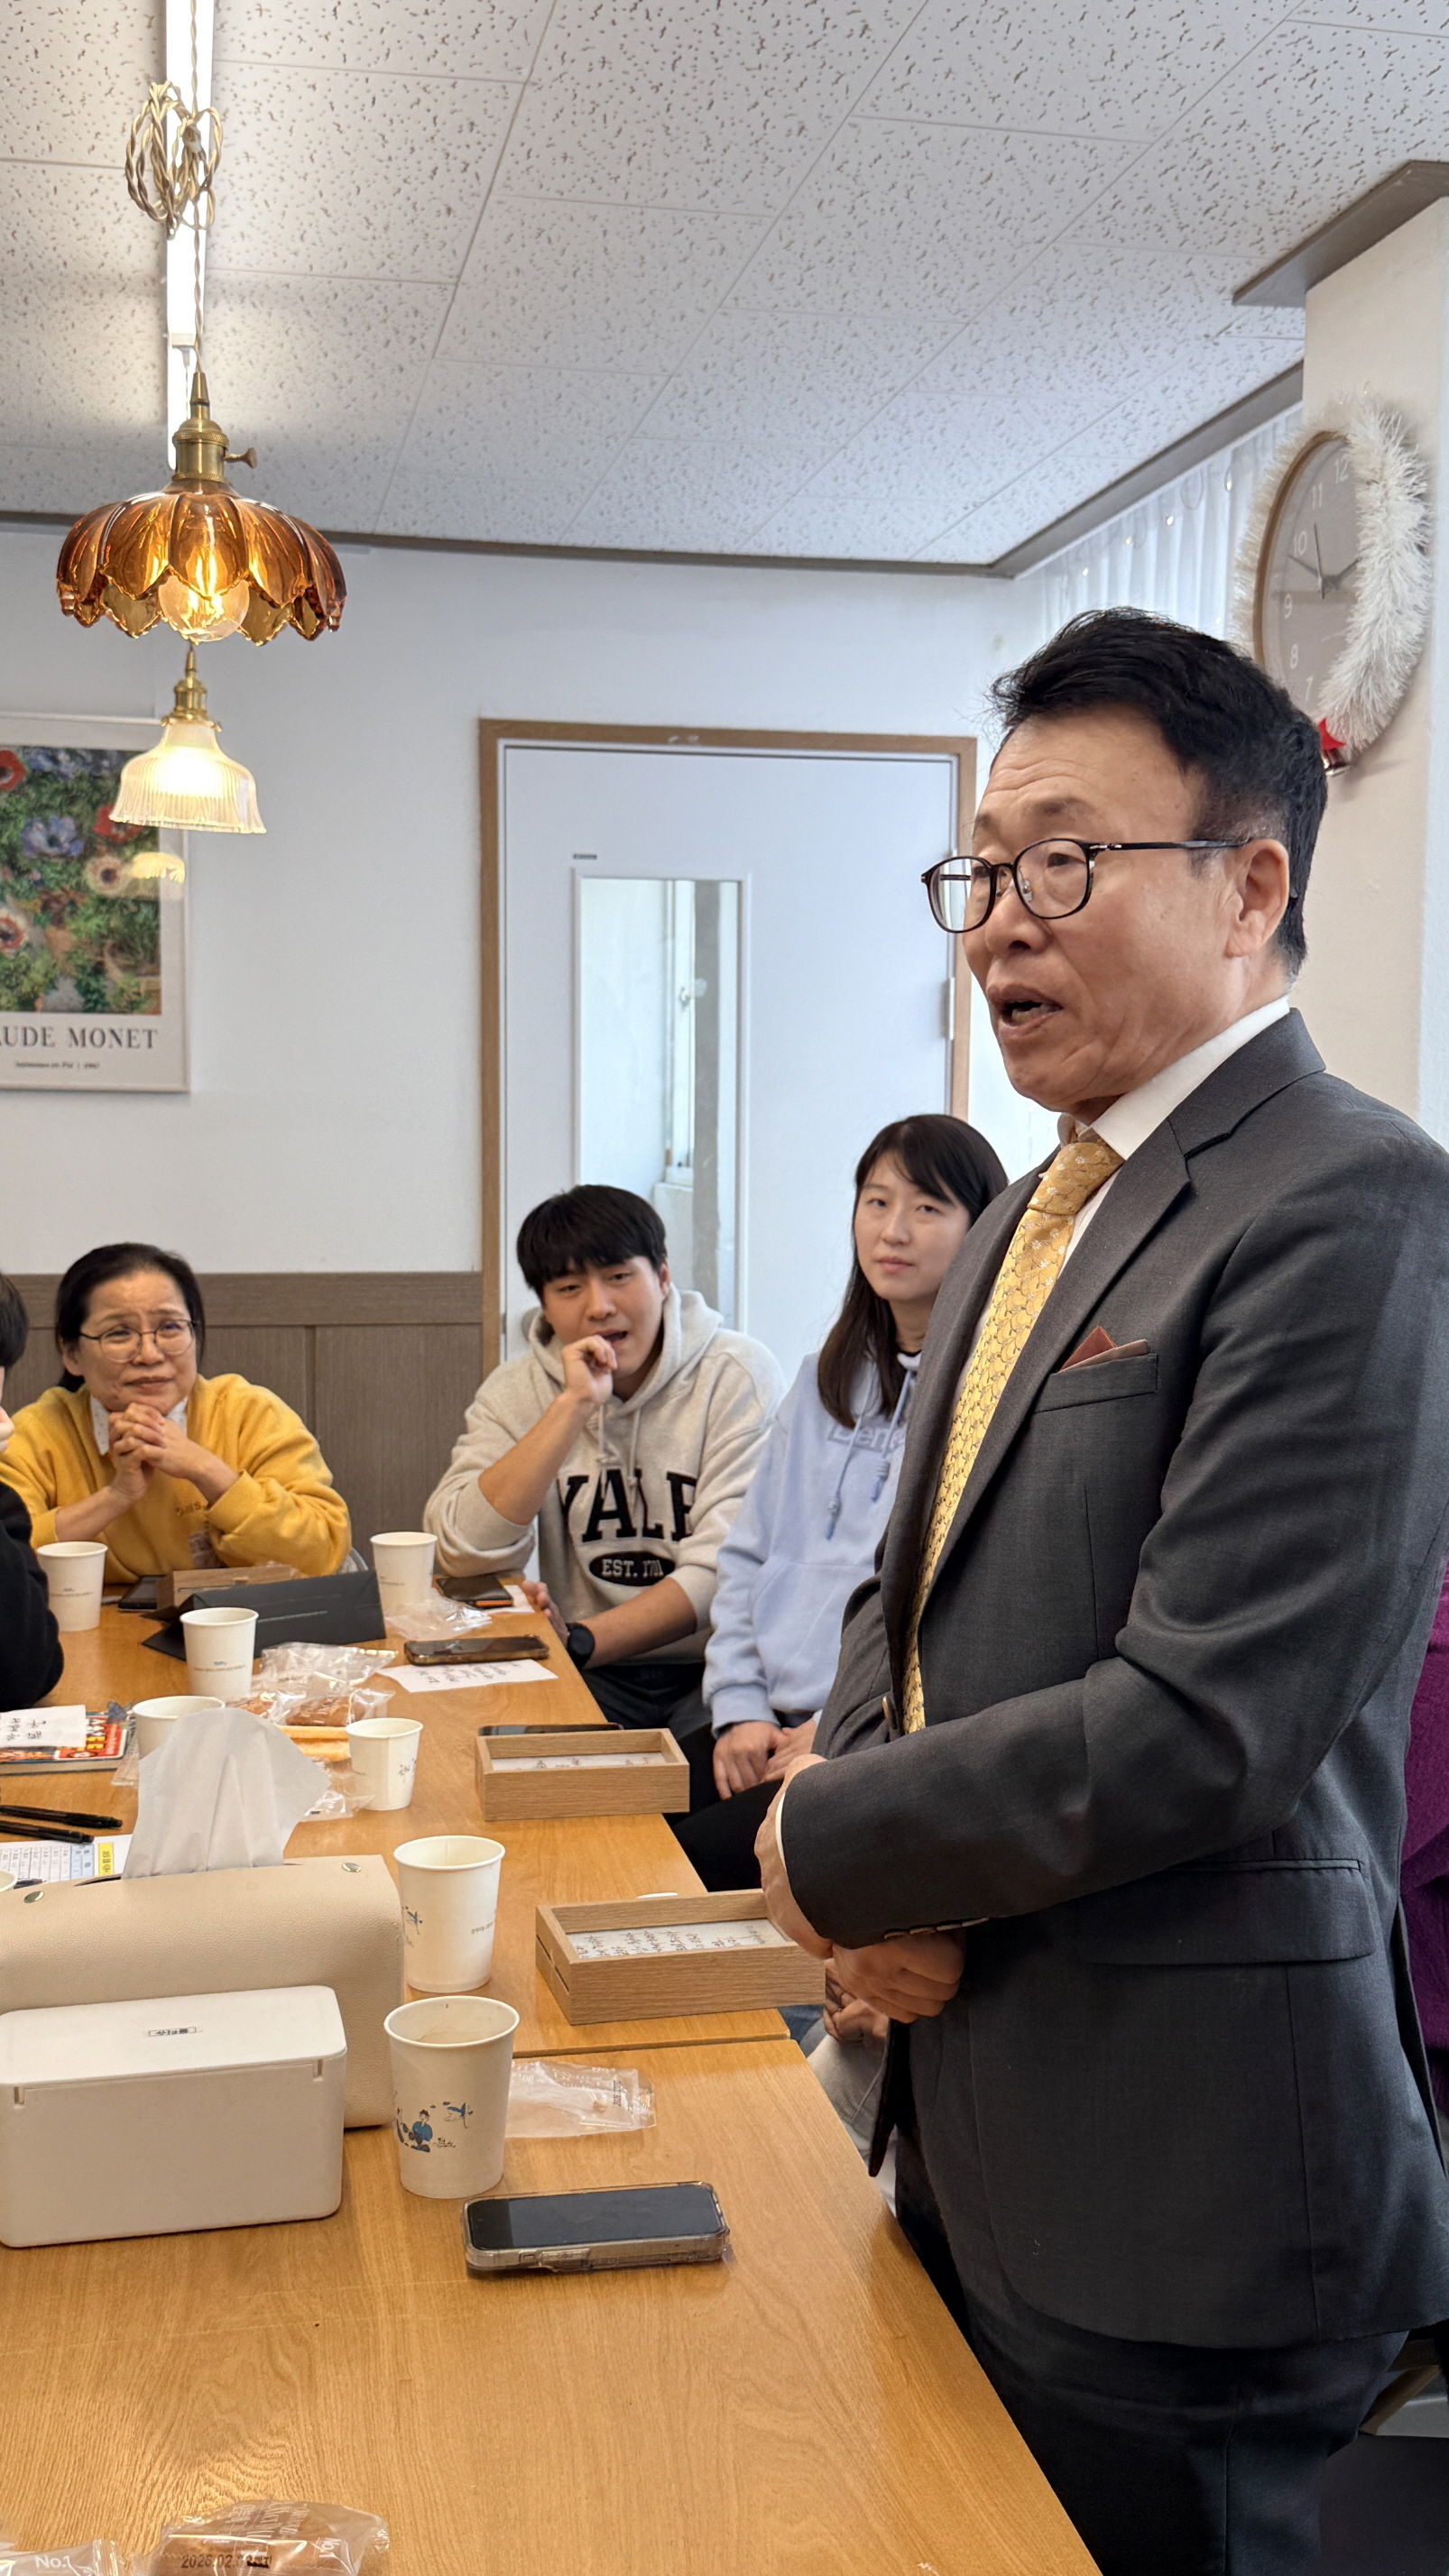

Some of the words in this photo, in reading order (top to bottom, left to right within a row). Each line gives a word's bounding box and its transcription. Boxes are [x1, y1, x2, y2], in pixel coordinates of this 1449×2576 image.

[1334, 457, 1349, 483] 12
[1311, 482, 1323, 510] 11
[1293, 530, 1307, 556] 10
[1283, 593, 1293, 619] 9
[1289, 642, 1299, 669] 8
[1305, 676, 1314, 701] 7
[0, 1025, 56, 1047] UDE
[68, 1026, 158, 1049] MONET
[601, 1559, 638, 1577] EST.
[641, 1559, 664, 1578] 1701
[319, 2537, 341, 2559] No.1
